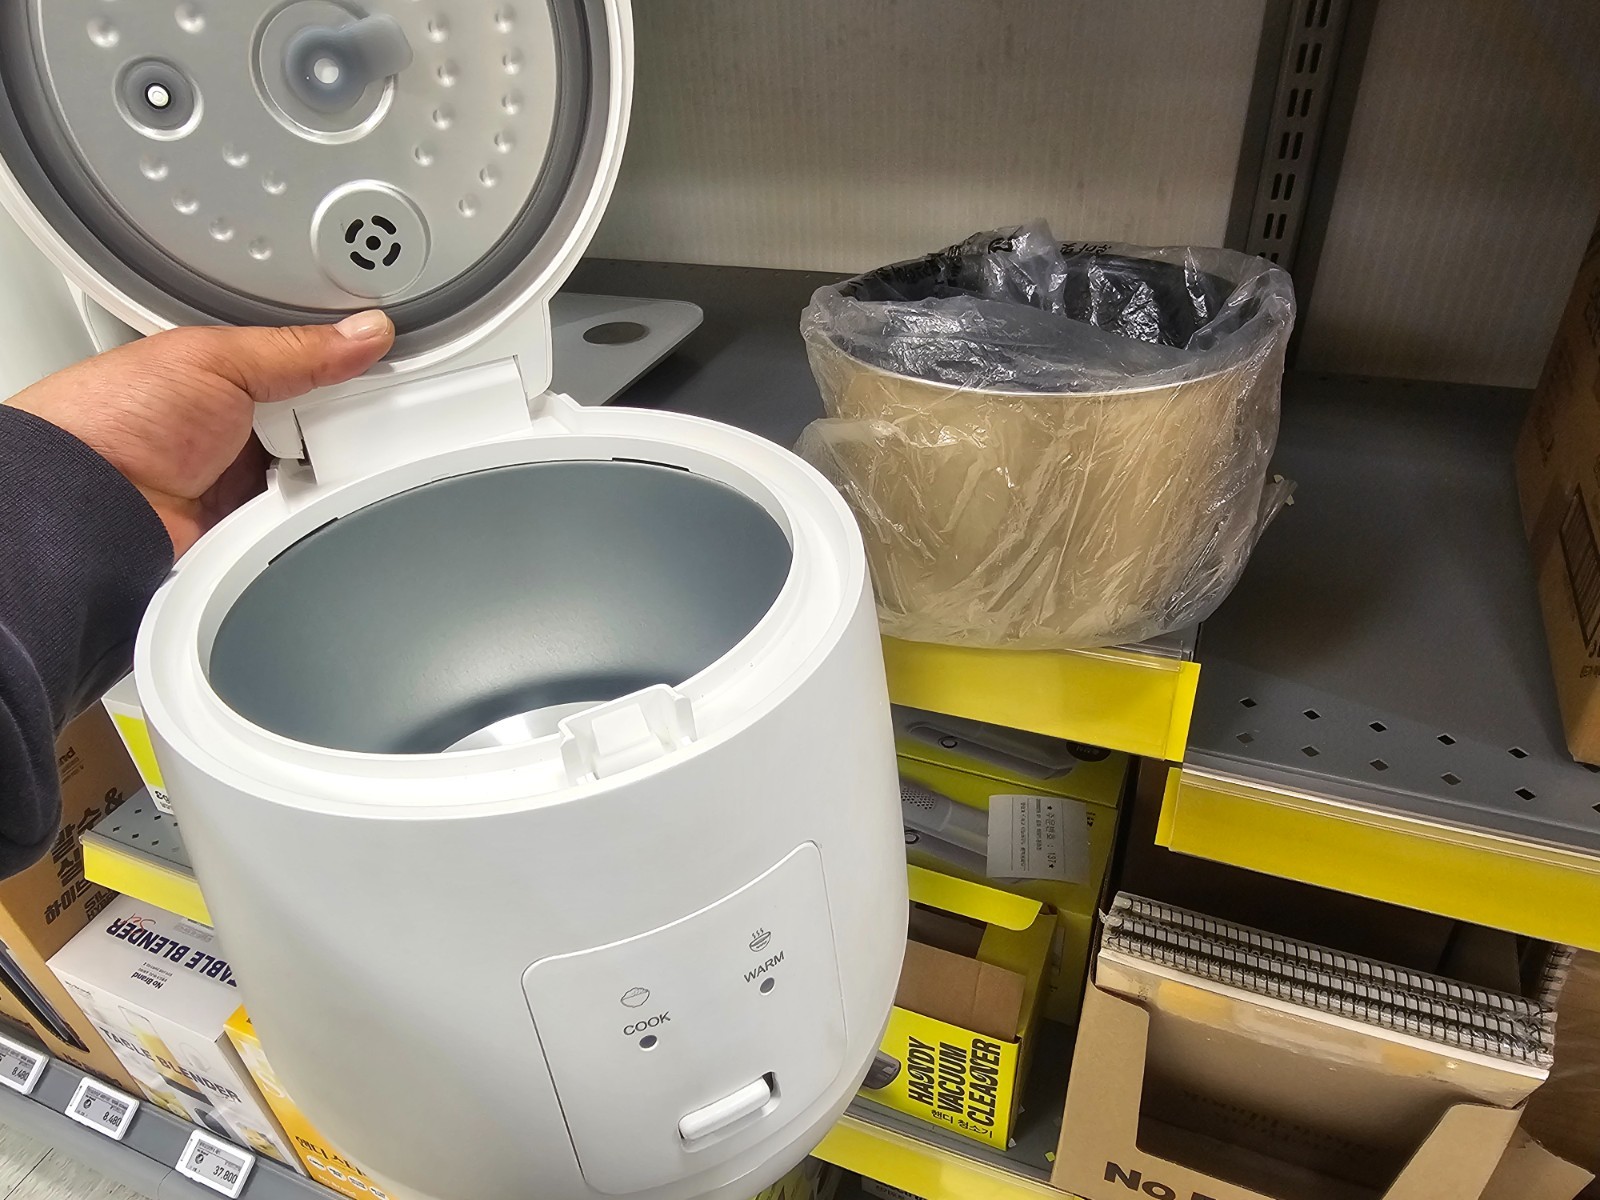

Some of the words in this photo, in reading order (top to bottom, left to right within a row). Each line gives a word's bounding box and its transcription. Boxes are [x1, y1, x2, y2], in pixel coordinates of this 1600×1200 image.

[106, 917, 191, 963] BLENDER
[131, 971, 153, 986] Brand
[183, 950, 237, 987] ABLE
[743, 950, 785, 983] WARM
[623, 1011, 671, 1036] COOK
[99, 1026, 155, 1062] TABLE
[156, 1055, 242, 1103] BLENDER
[907, 1035, 935, 1107] HANDY
[937, 1041, 967, 1115] VACUUM
[966, 1038, 1001, 1127] CLEANER
[931, 1109, 954, 1124] 핸디
[957, 1119, 993, 1139] 청소기
[1103, 1161, 1177, 1200] No
